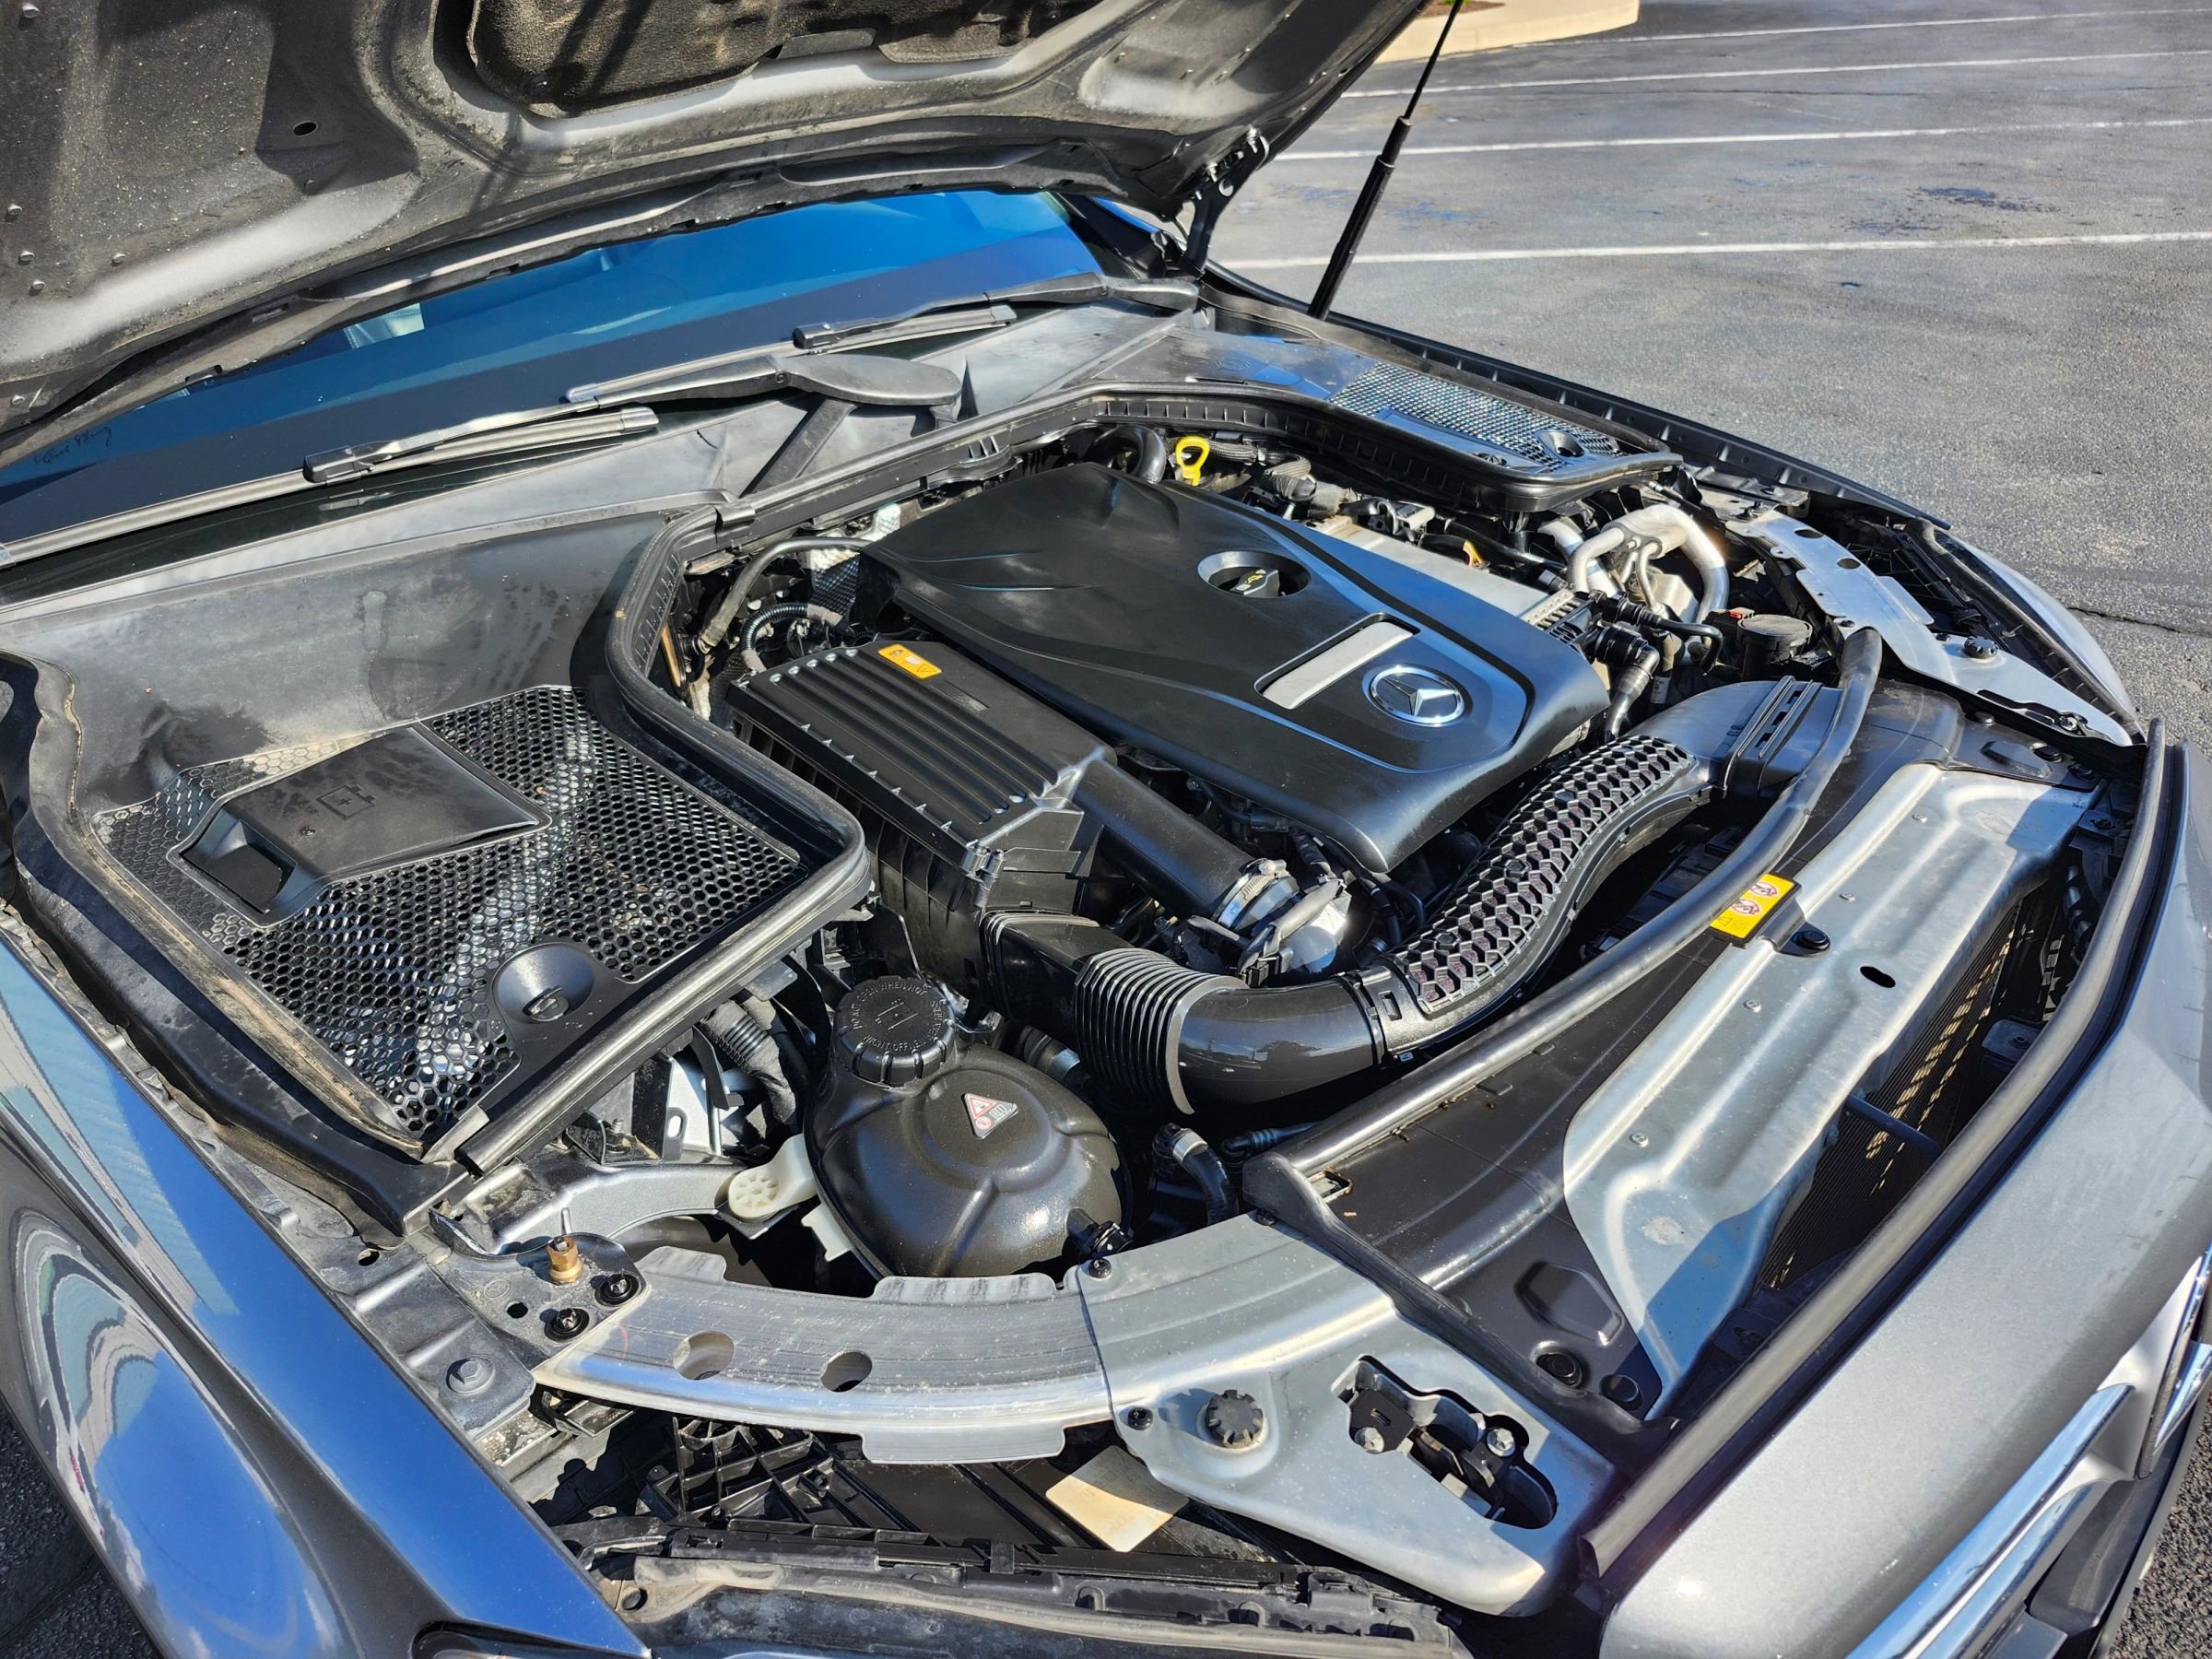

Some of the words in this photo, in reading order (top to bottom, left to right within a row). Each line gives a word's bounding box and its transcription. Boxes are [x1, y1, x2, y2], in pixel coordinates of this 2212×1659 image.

[850, 1018, 864, 1030] DO
[881, 981, 907, 991] WHEN
[907, 983, 928, 996] HOT
[863, 1033, 891, 1051] NICHT
